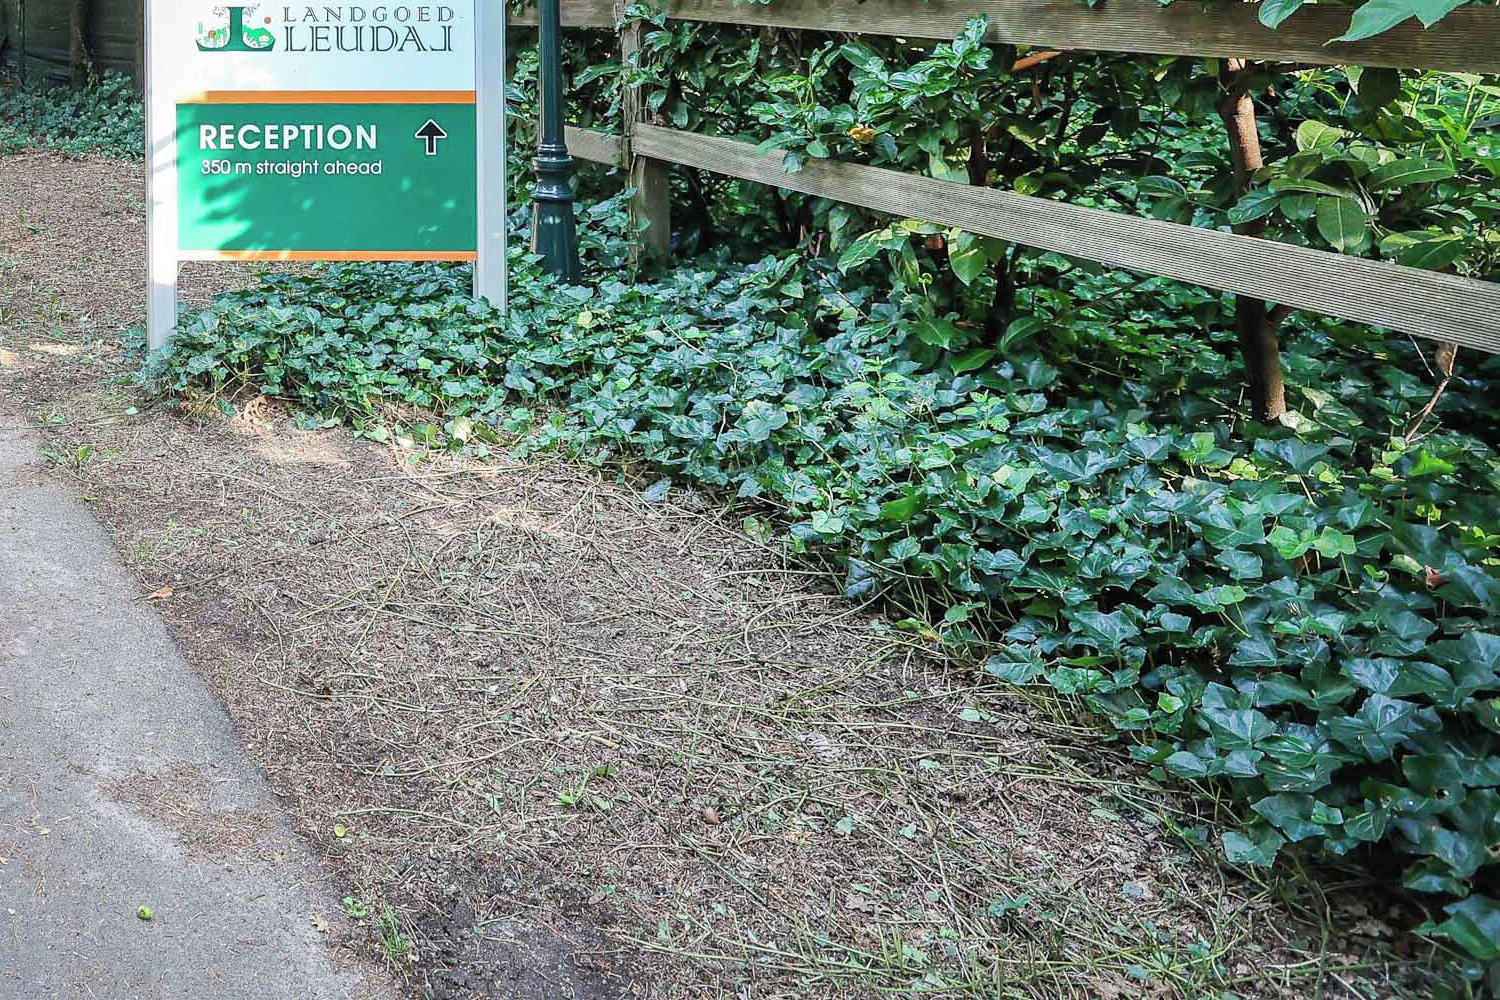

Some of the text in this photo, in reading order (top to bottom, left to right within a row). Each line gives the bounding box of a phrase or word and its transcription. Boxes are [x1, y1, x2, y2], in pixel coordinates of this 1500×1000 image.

[283, 6, 454, 23] LANDGOED
[199, 124, 377, 150] RECEPTION
[200, 159, 382, 178] 350 m straight ahead
